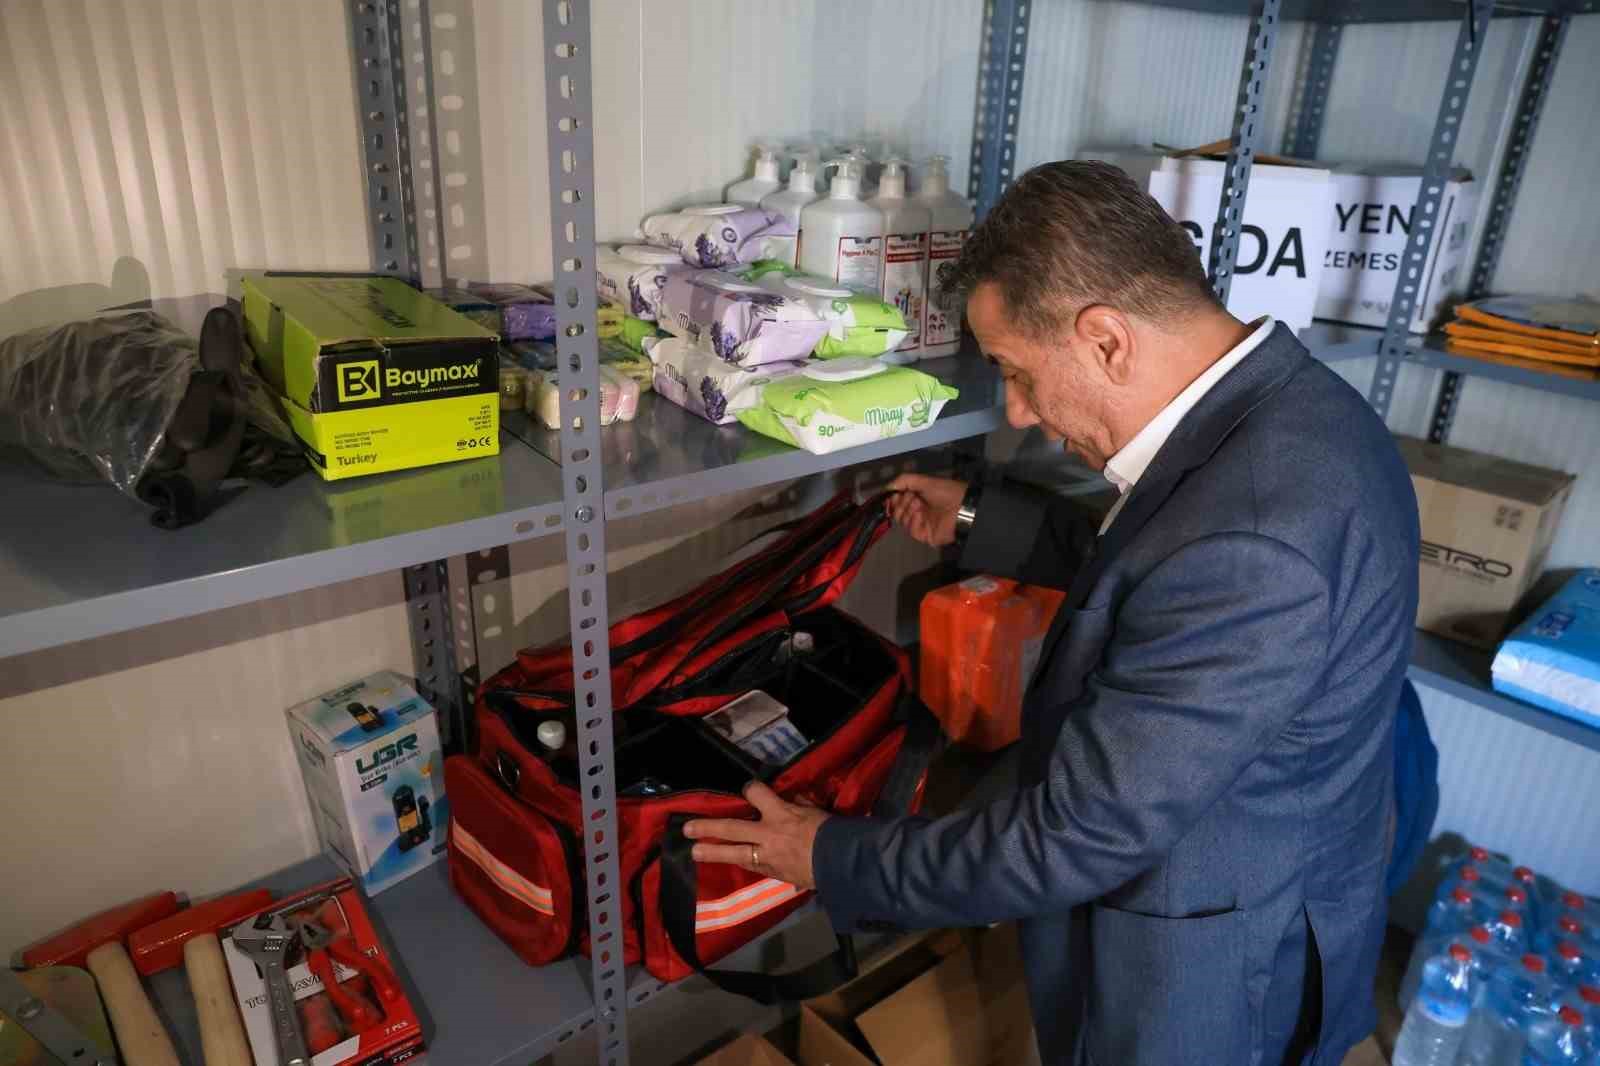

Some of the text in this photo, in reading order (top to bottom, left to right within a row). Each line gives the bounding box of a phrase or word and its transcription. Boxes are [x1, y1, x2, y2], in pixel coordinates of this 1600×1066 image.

[865, 407, 903, 427] Miray
[818, 424, 834, 437] 90
[336, 453, 378, 466] Turkey
